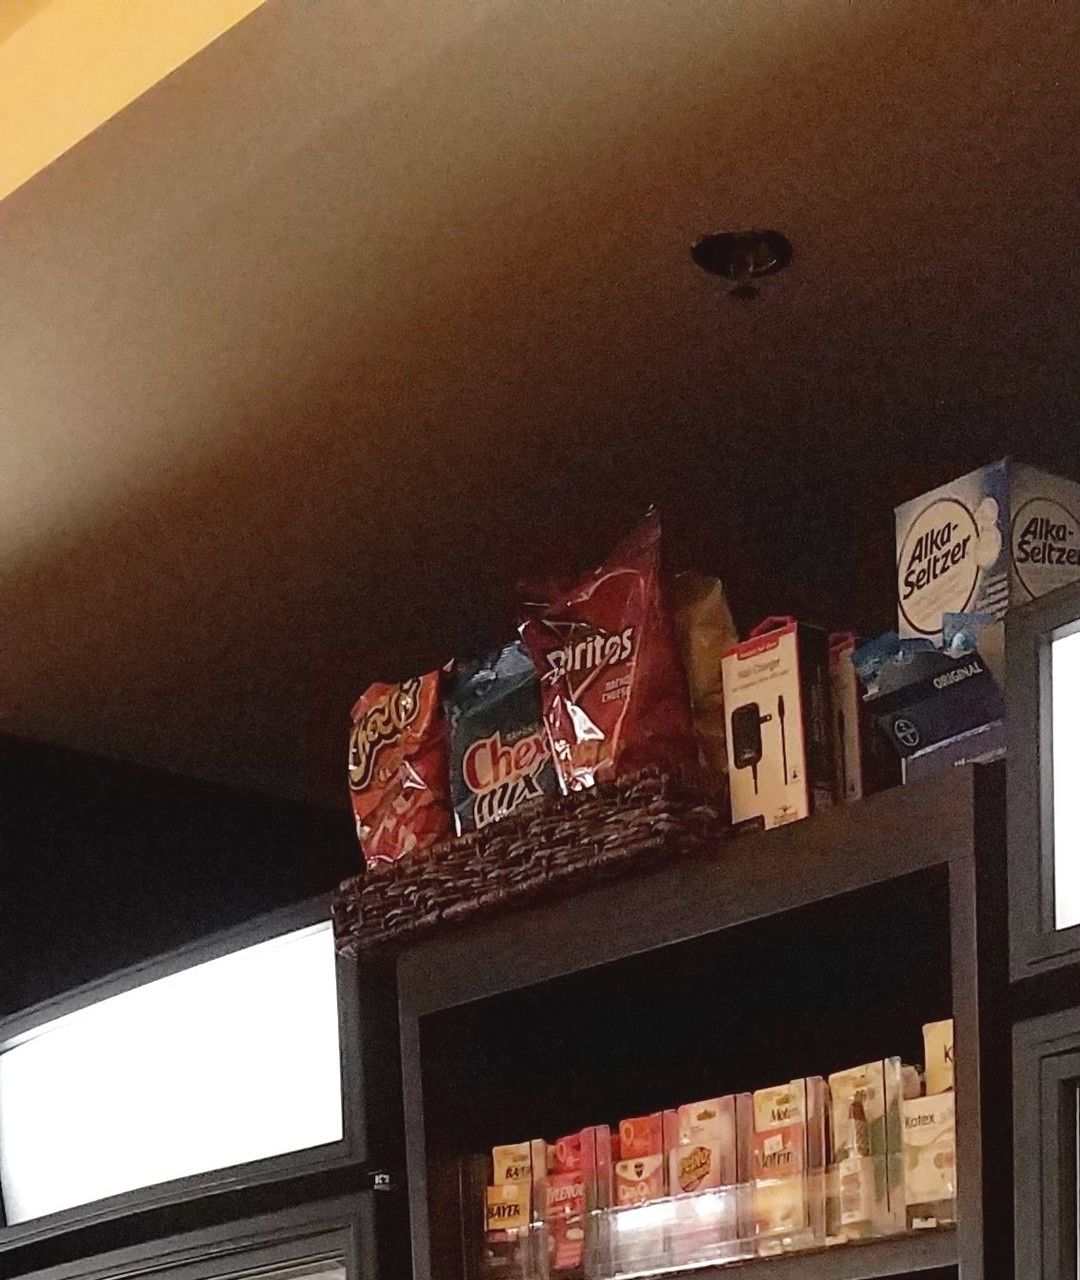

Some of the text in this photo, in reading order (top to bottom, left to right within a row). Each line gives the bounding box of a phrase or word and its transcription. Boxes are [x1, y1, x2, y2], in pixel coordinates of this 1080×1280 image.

[1020, 517, 1074, 542] Alka-
[907, 522, 958, 571] Alka-
[902, 535, 971, 600] Seltzer
[932, 662, 983, 689] ORIGINAL
[904, 1112, 936, 1130] Kotex
